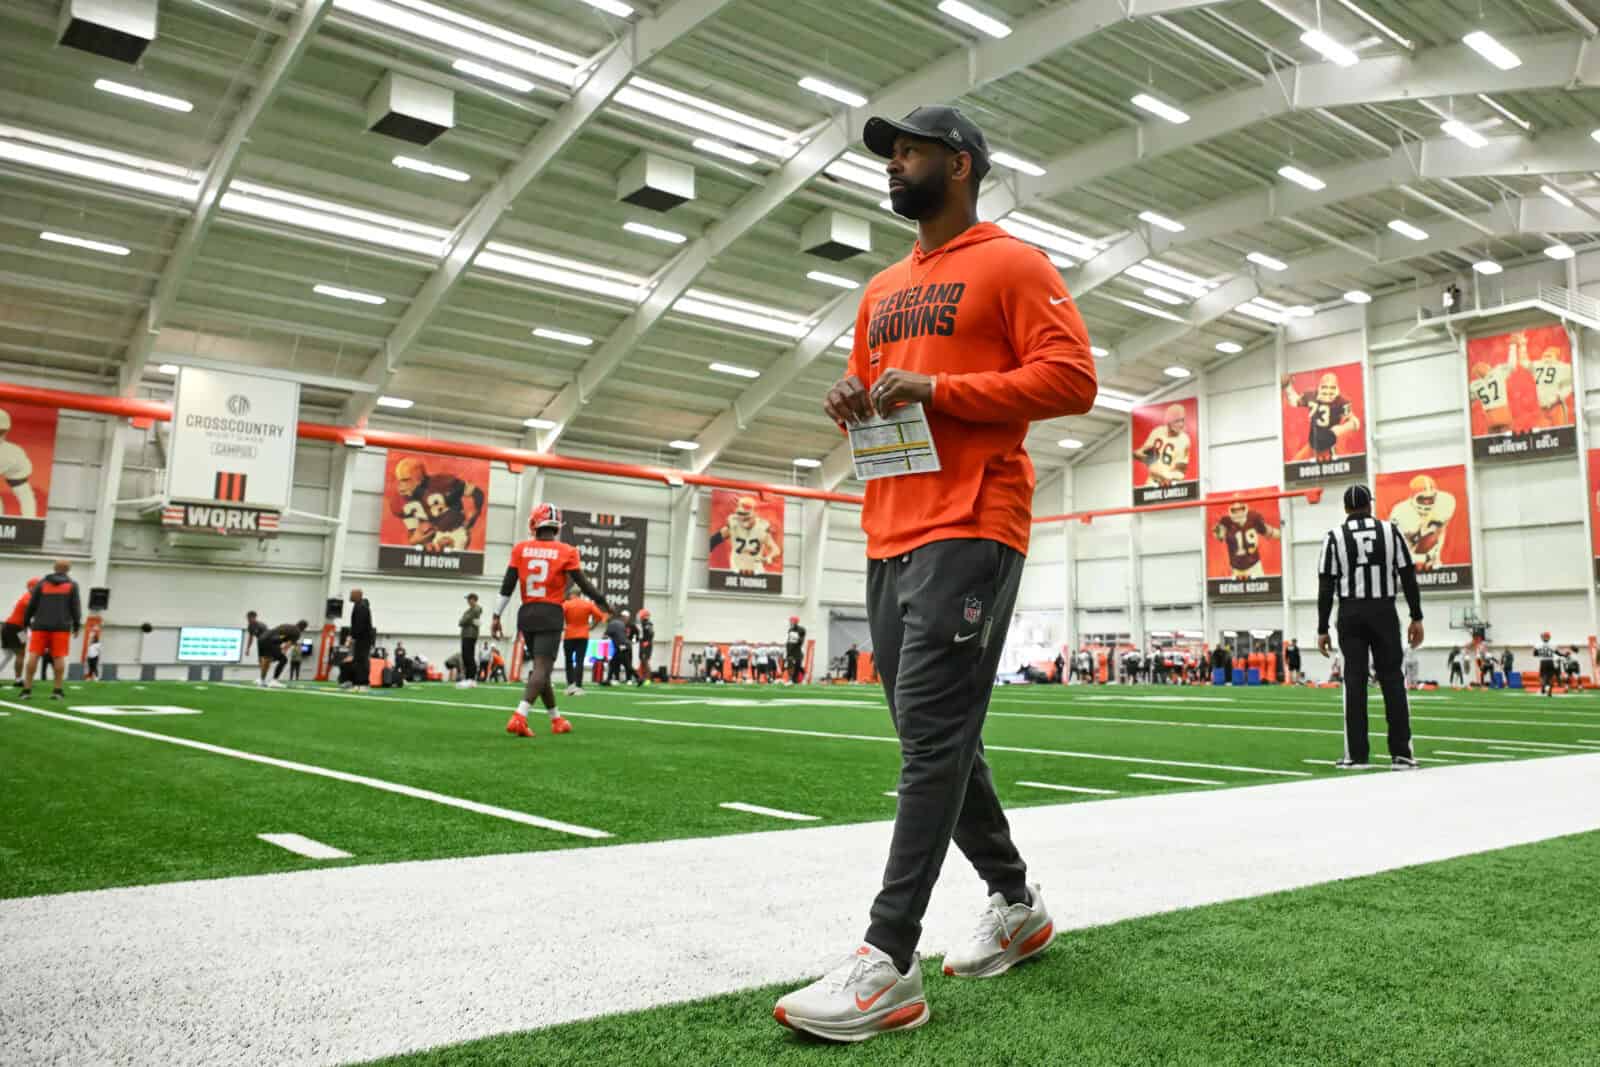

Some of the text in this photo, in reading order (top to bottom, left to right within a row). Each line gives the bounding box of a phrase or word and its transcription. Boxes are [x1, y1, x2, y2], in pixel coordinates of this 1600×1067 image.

[868, 304, 957, 350] BROWNS
[1477, 380, 1500, 405] 57
[185, 413, 285, 438] CROSSCOUNTRY
[187, 506, 258, 530] WORK
[607, 547, 632, 559] 1950
[1352, 530, 1377, 565] F
[404, 553, 461, 569] JIM BROWN
[607, 562, 631, 575] 1954
[526, 559, 549, 598] 2
